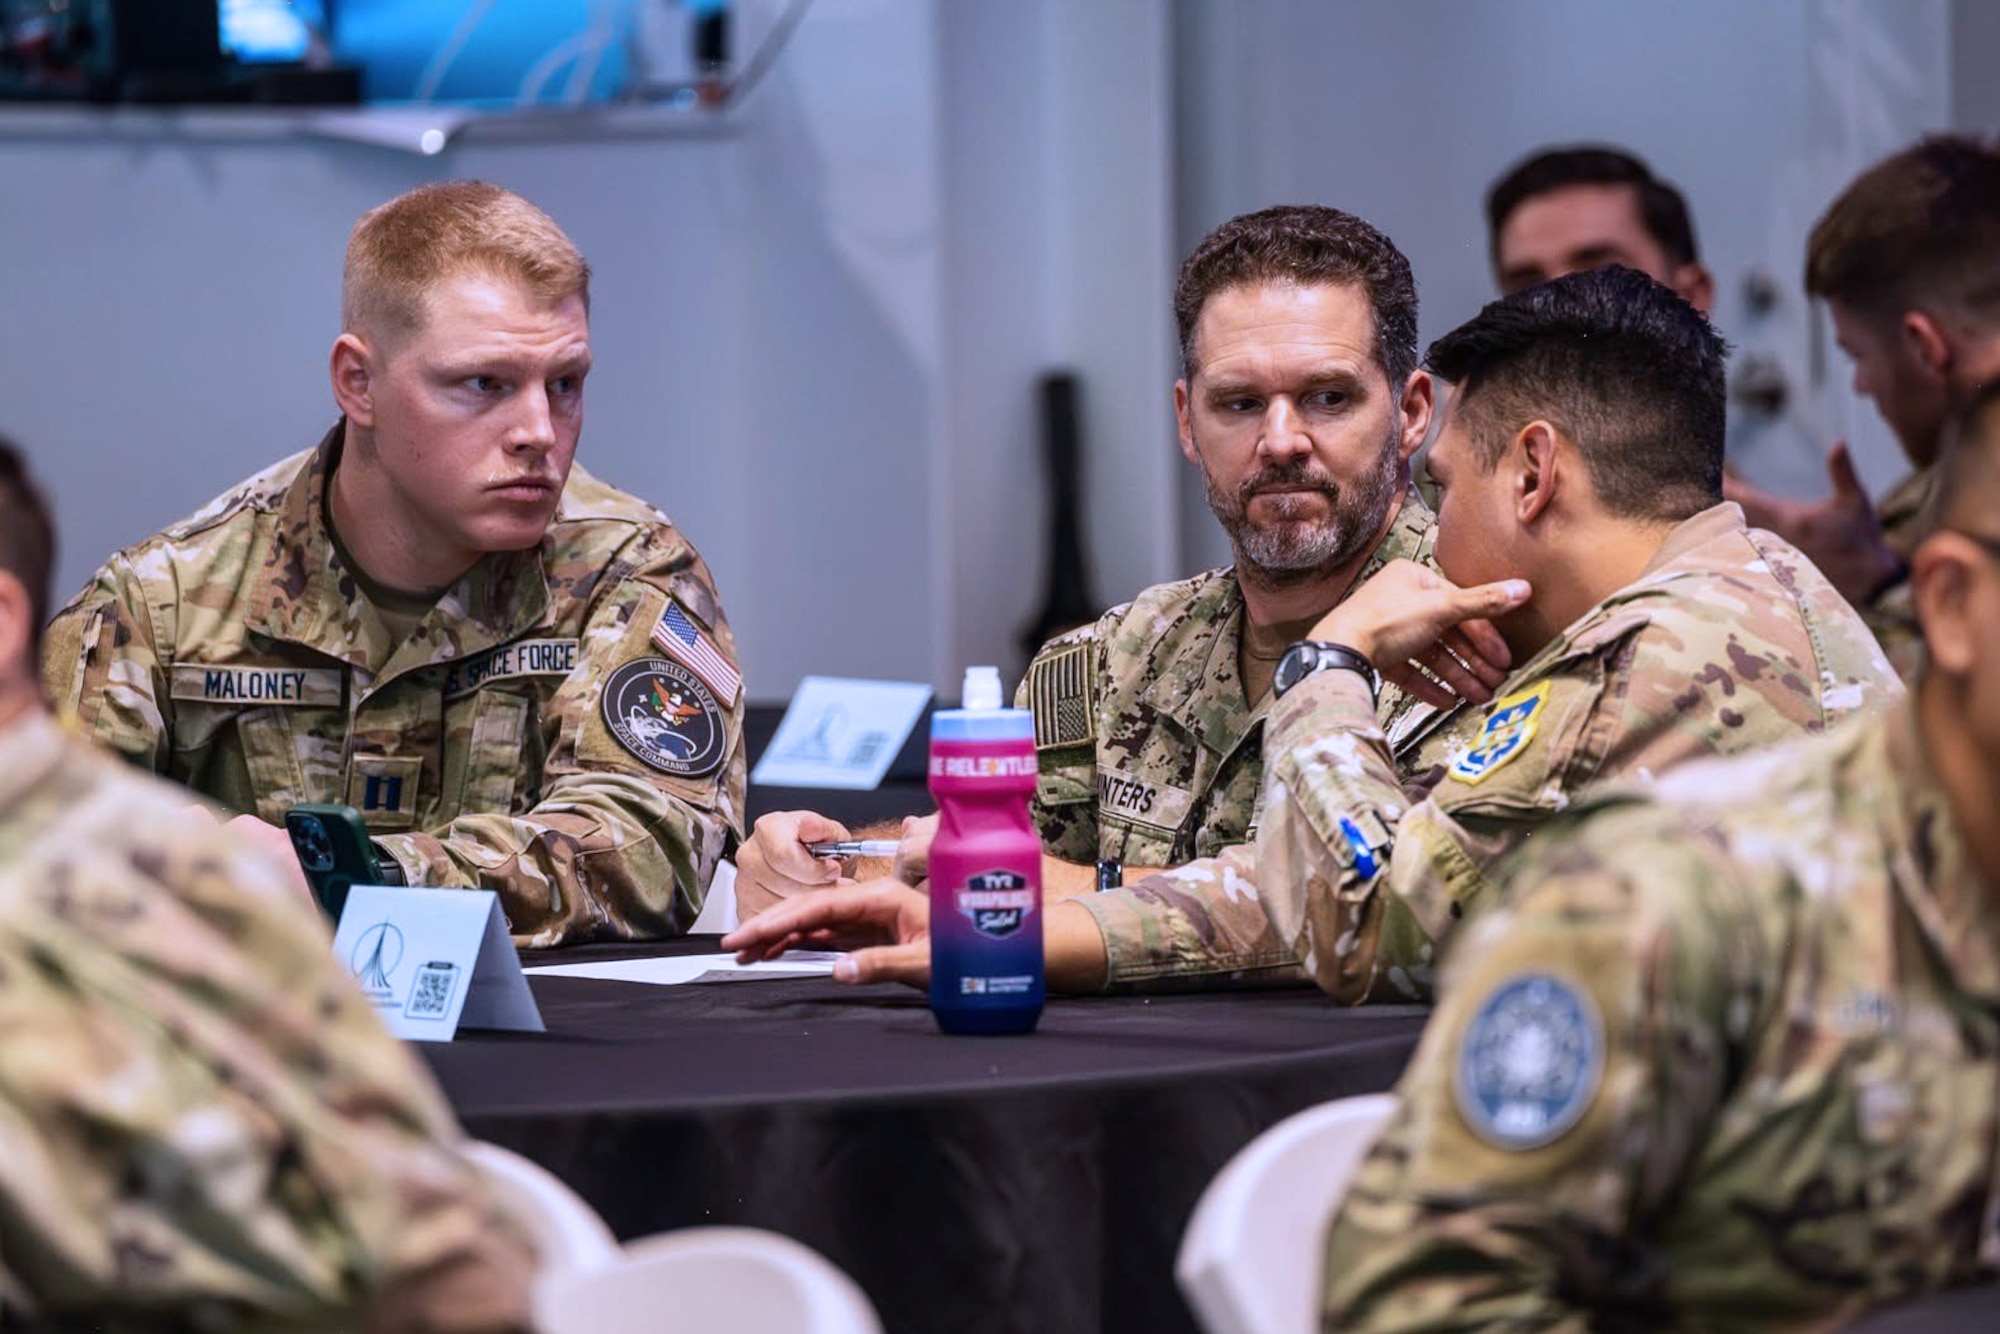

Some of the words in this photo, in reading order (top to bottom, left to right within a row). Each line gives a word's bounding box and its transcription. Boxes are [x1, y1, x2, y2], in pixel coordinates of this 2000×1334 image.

[518, 644, 577, 672] FORCE
[205, 671, 306, 699] MALONEY
[649, 661, 688, 682] UNITED
[687, 677, 718, 713] STATES
[614, 723, 638, 750] SPACE
[639, 746, 690, 771] COMMAND
